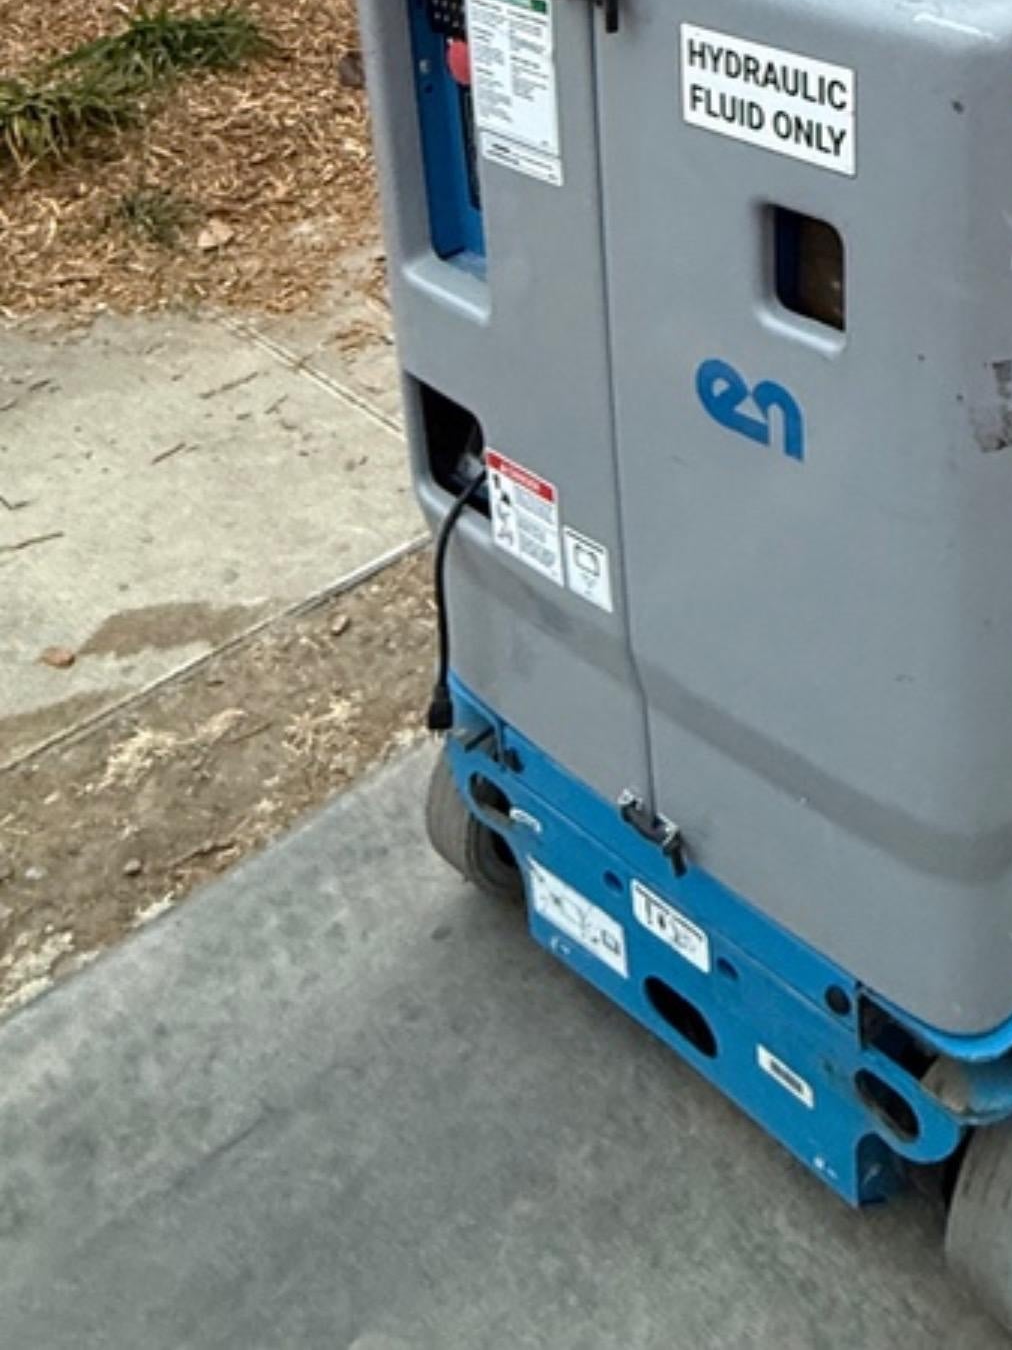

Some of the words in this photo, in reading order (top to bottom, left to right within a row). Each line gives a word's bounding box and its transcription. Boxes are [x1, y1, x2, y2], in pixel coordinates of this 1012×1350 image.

[687, 37, 848, 112] HYDRAULIC
[689, 83, 766, 130] FLUID
[772, 110, 847, 157] ONLY
